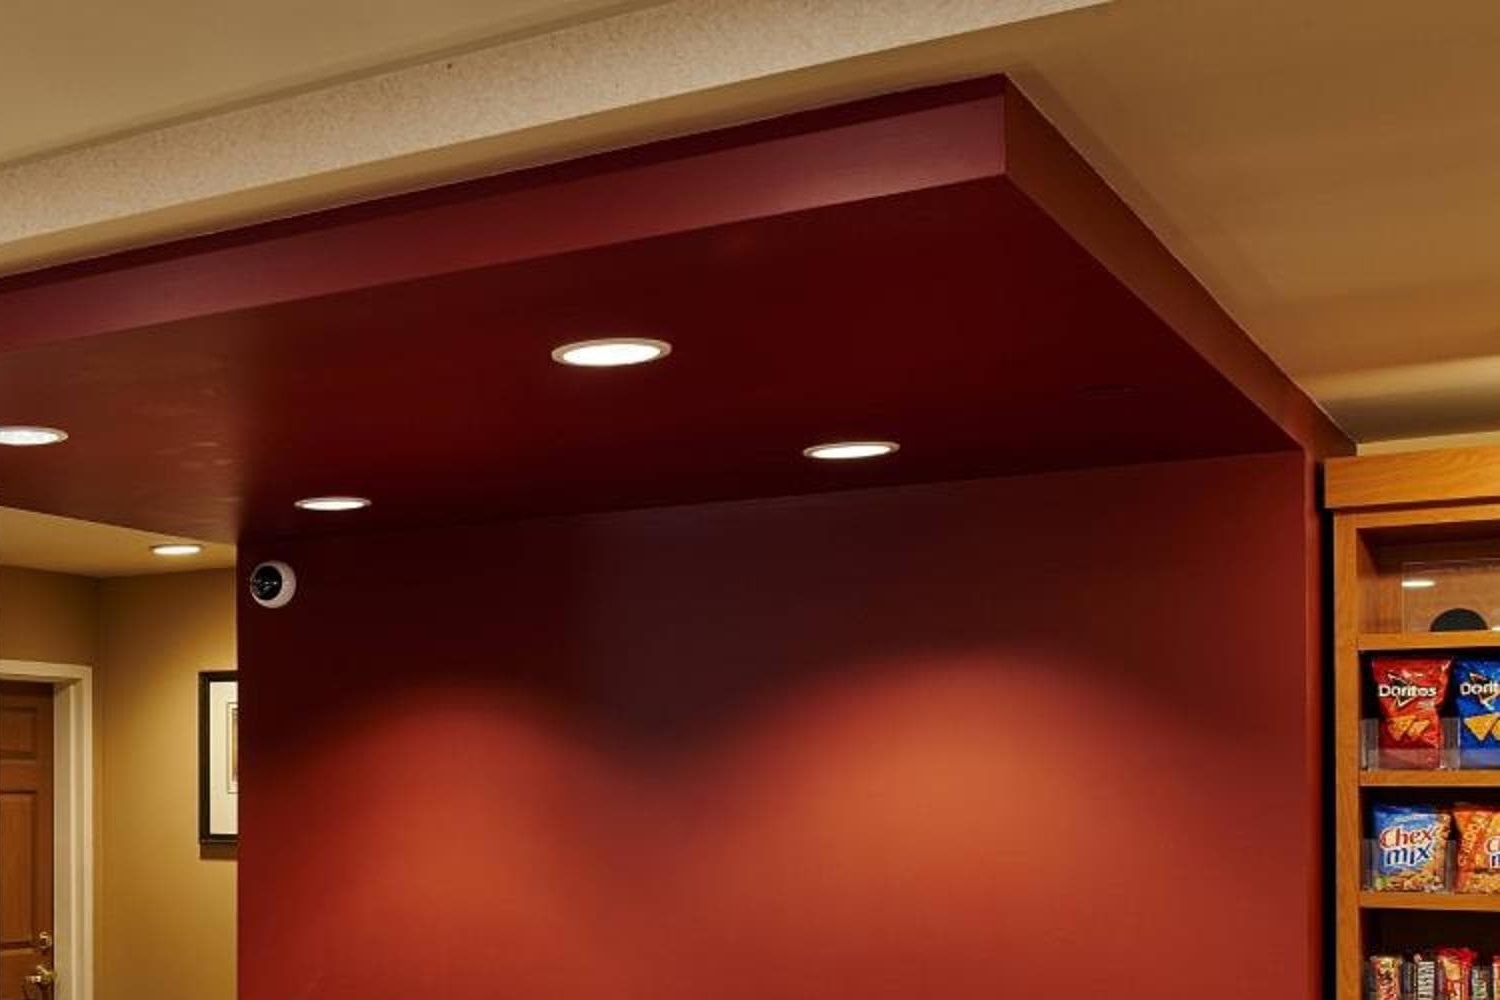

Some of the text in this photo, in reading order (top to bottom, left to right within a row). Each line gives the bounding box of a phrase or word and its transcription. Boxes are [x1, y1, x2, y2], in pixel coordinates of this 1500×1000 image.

[1379, 683, 1437, 697] Doritos
[1380, 825, 1433, 850] Chex
[1384, 845, 1430, 866] mix
